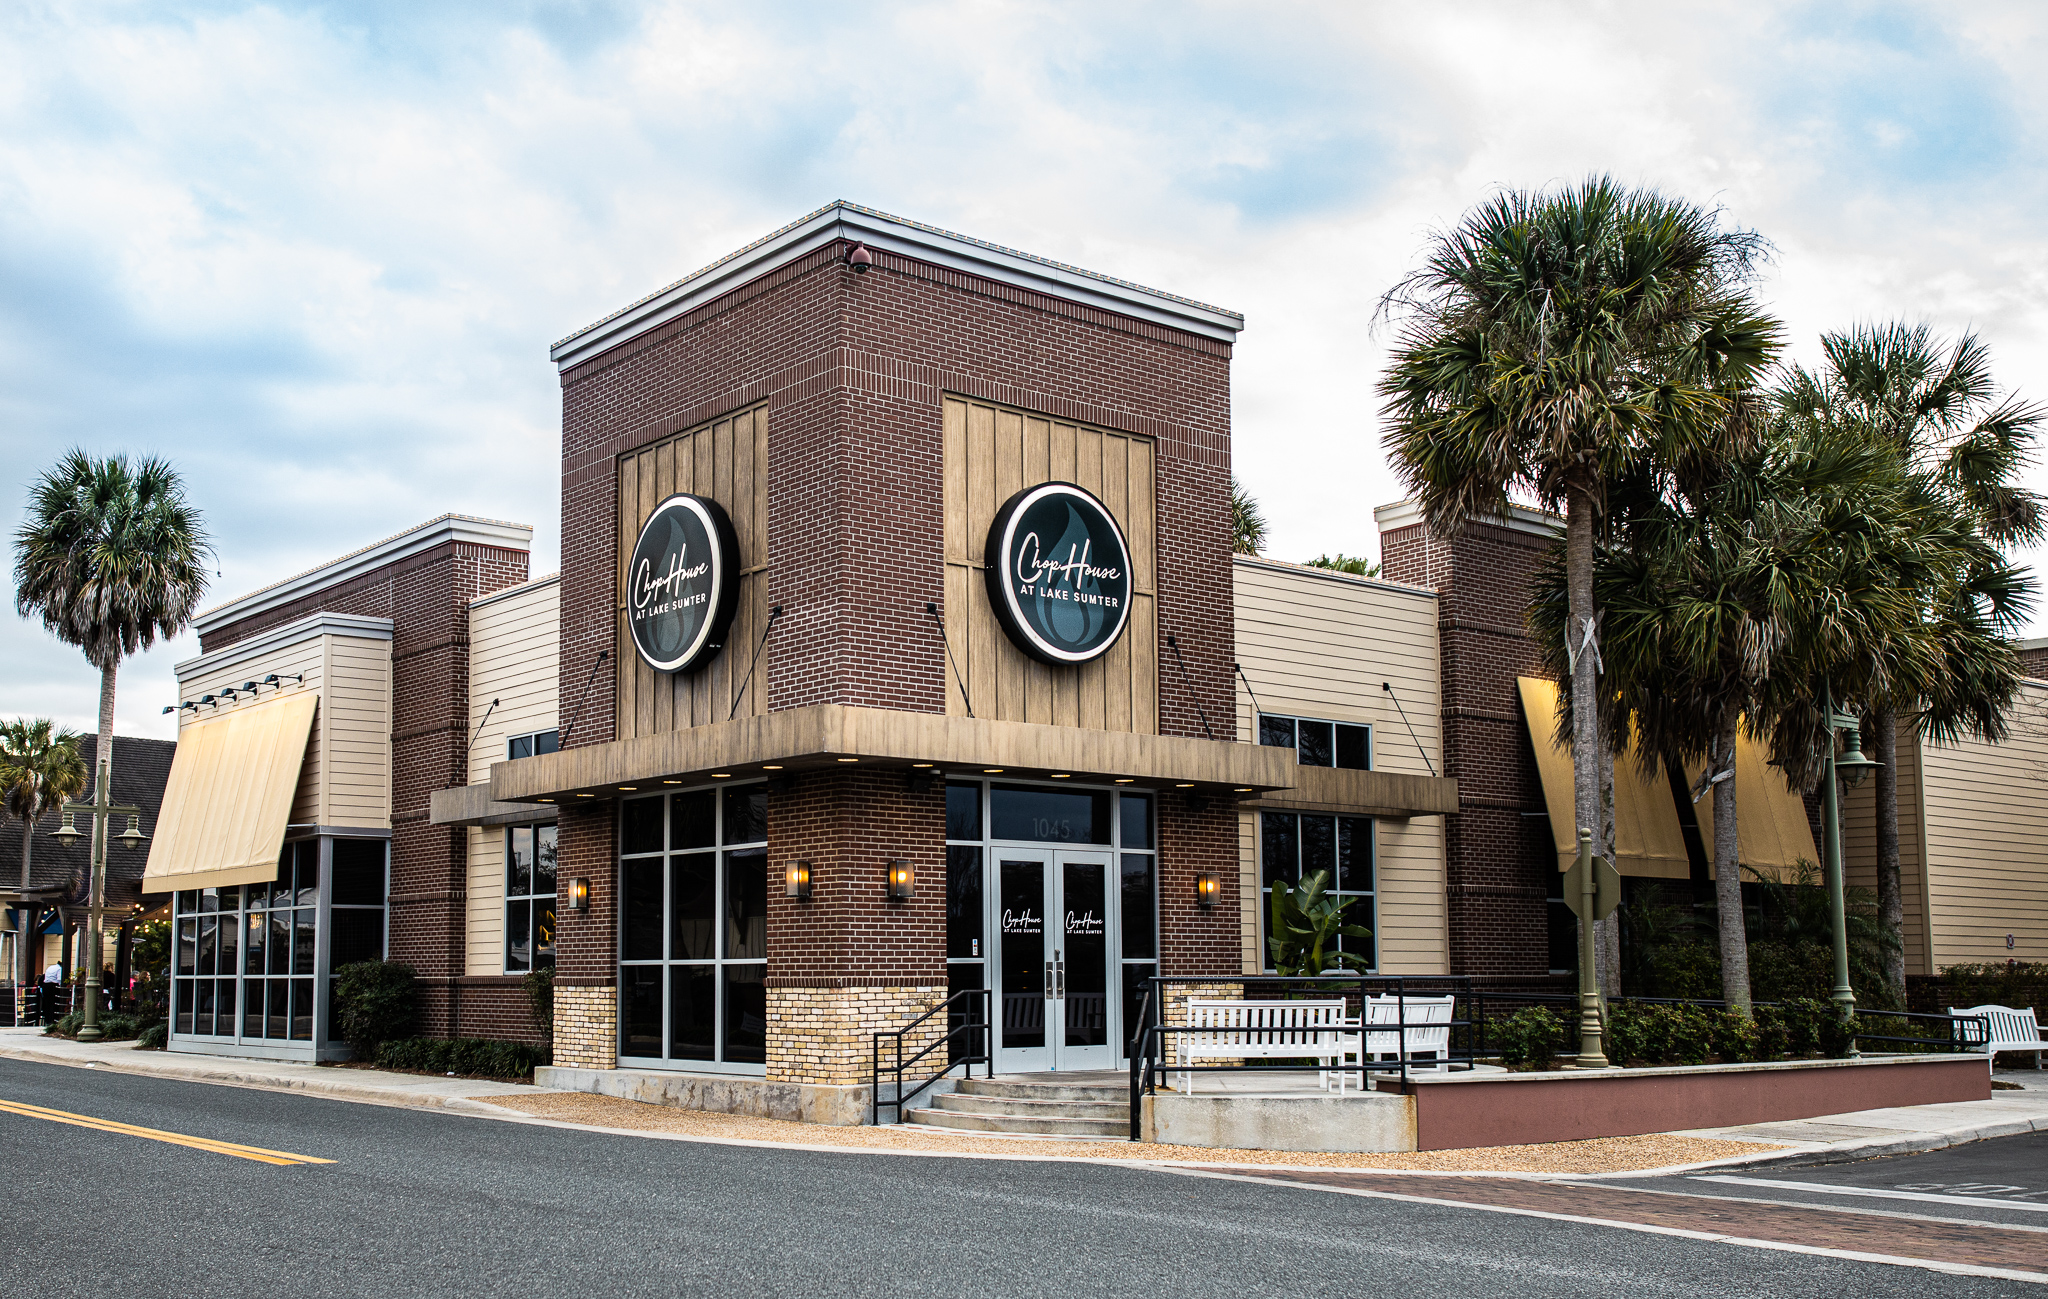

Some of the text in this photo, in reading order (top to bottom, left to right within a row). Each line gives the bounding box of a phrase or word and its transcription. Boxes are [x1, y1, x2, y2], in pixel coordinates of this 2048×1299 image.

[635, 592, 707, 621] AT LAKE SUMTER
[1020, 584, 1119, 608] AT LAKE SUMTER
[1032, 817, 1070, 839] 1045
